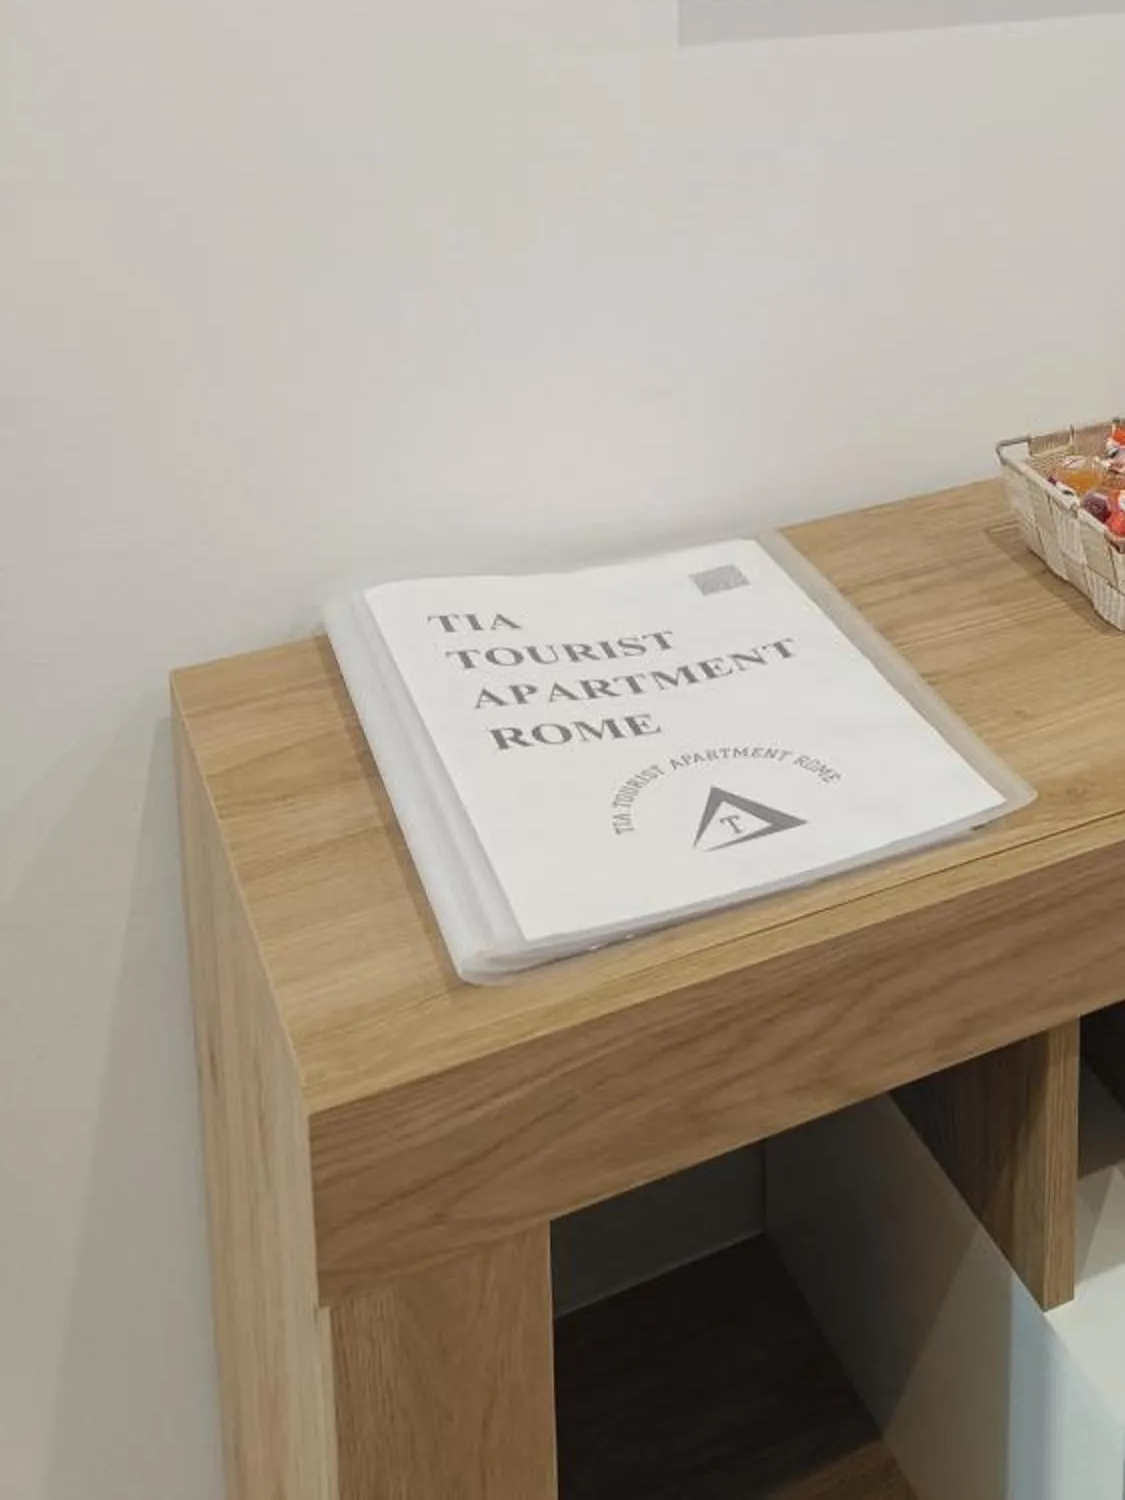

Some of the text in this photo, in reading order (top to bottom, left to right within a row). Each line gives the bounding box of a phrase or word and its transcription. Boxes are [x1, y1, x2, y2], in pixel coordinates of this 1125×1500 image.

[427, 612, 522, 634] TIA
[445, 630, 674, 670] TOURIST
[474, 638, 794, 710] APARTMENT
[489, 713, 662, 751] ROME
[612, 746, 842, 836] TIA TOURIST APARTMENT ROME
[719, 815, 742, 834] T
